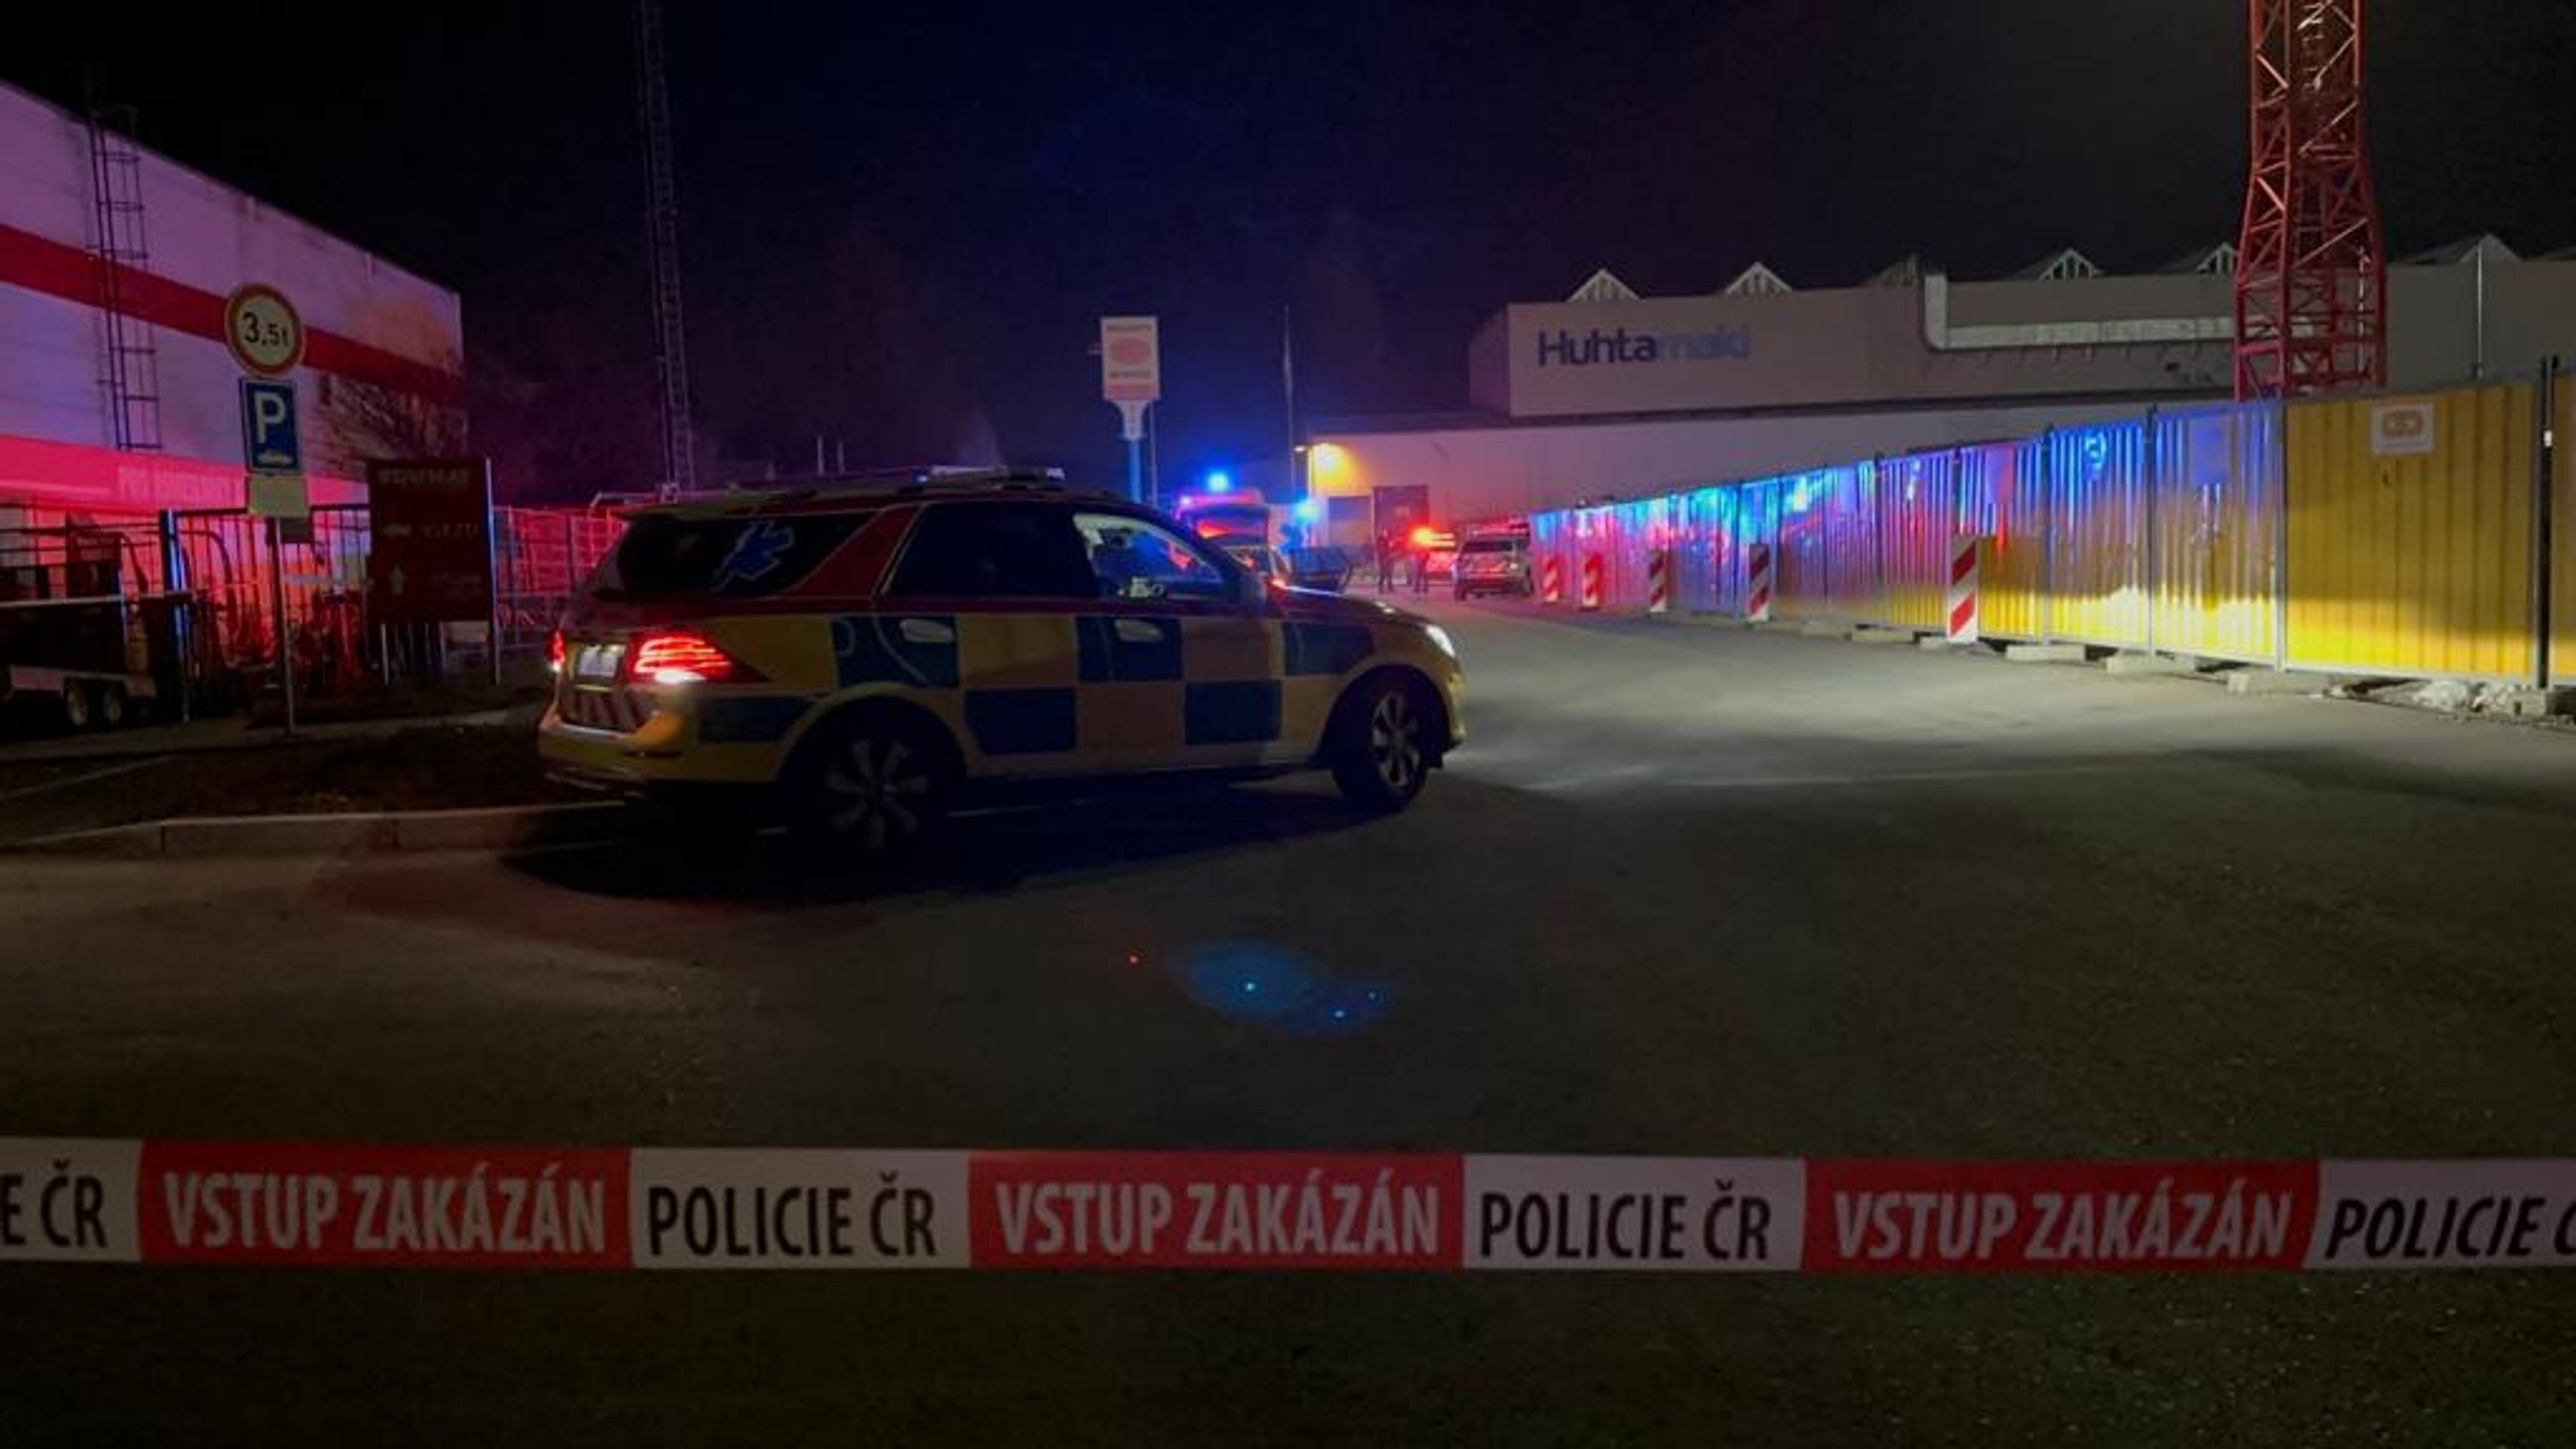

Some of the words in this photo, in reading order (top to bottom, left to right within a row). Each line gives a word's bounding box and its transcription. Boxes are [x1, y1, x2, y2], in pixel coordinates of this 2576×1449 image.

[1537, 325, 1751, 367] Huhtamaki
[254, 391, 287, 445] P
[42, 1158, 106, 1248] ČR
[162, 1170, 340, 1250] VSTUP
[352, 1161, 605, 1254] ZAKÁZÁN
[649, 1187, 853, 1256] POLICIE
[870, 1171, 937, 1257] ČR
[996, 1182, 1172, 1254] VSTUP
[1186, 1168, 1439, 1255] ZAKÁZÁN
[1481, 1193, 1685, 1259] POLICIE
[1703, 1180, 1771, 1260] ČR
[1832, 1189, 2018, 1260] VSTUP
[2024, 1175, 2294, 1260] ZAKÁZÁN
[2326, 1197, 2546, 1258] POLICIE
